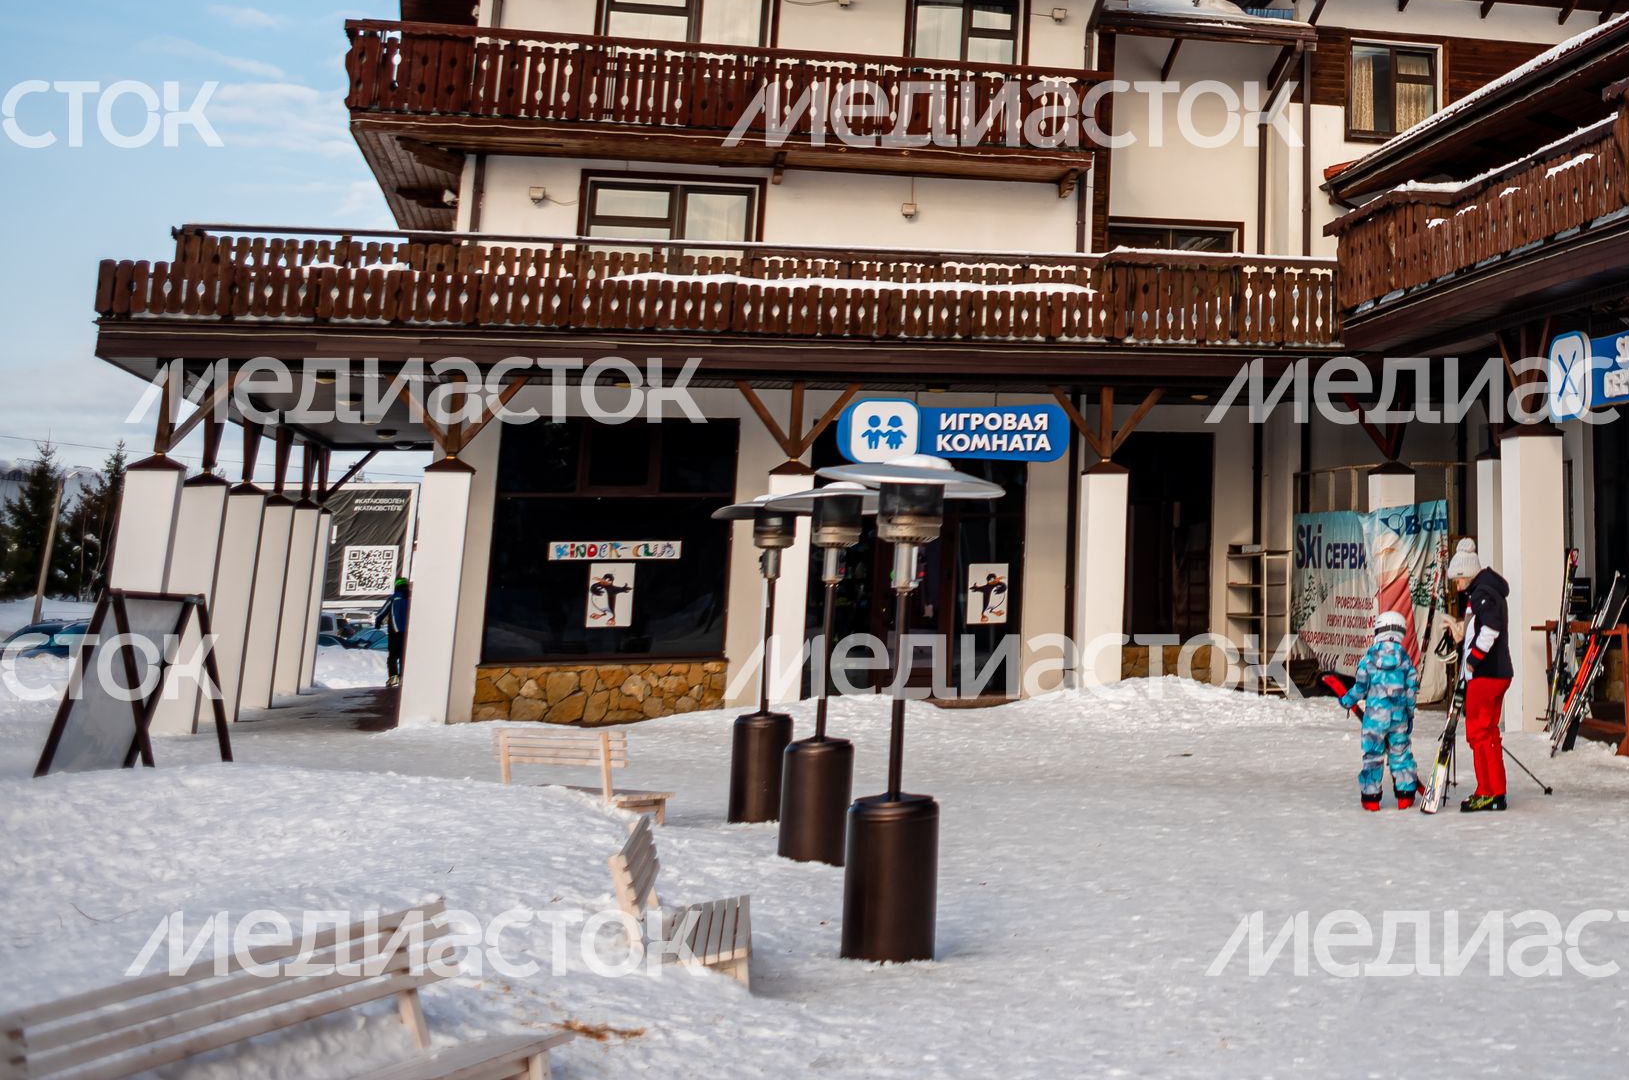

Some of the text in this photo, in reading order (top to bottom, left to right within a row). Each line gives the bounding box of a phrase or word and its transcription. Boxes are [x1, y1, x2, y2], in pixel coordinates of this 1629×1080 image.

[940, 412, 1049, 431] ИГРОВАЯ
[936, 433, 1052, 452] КОМНАТА
[1295, 523, 1323, 570] Ski
